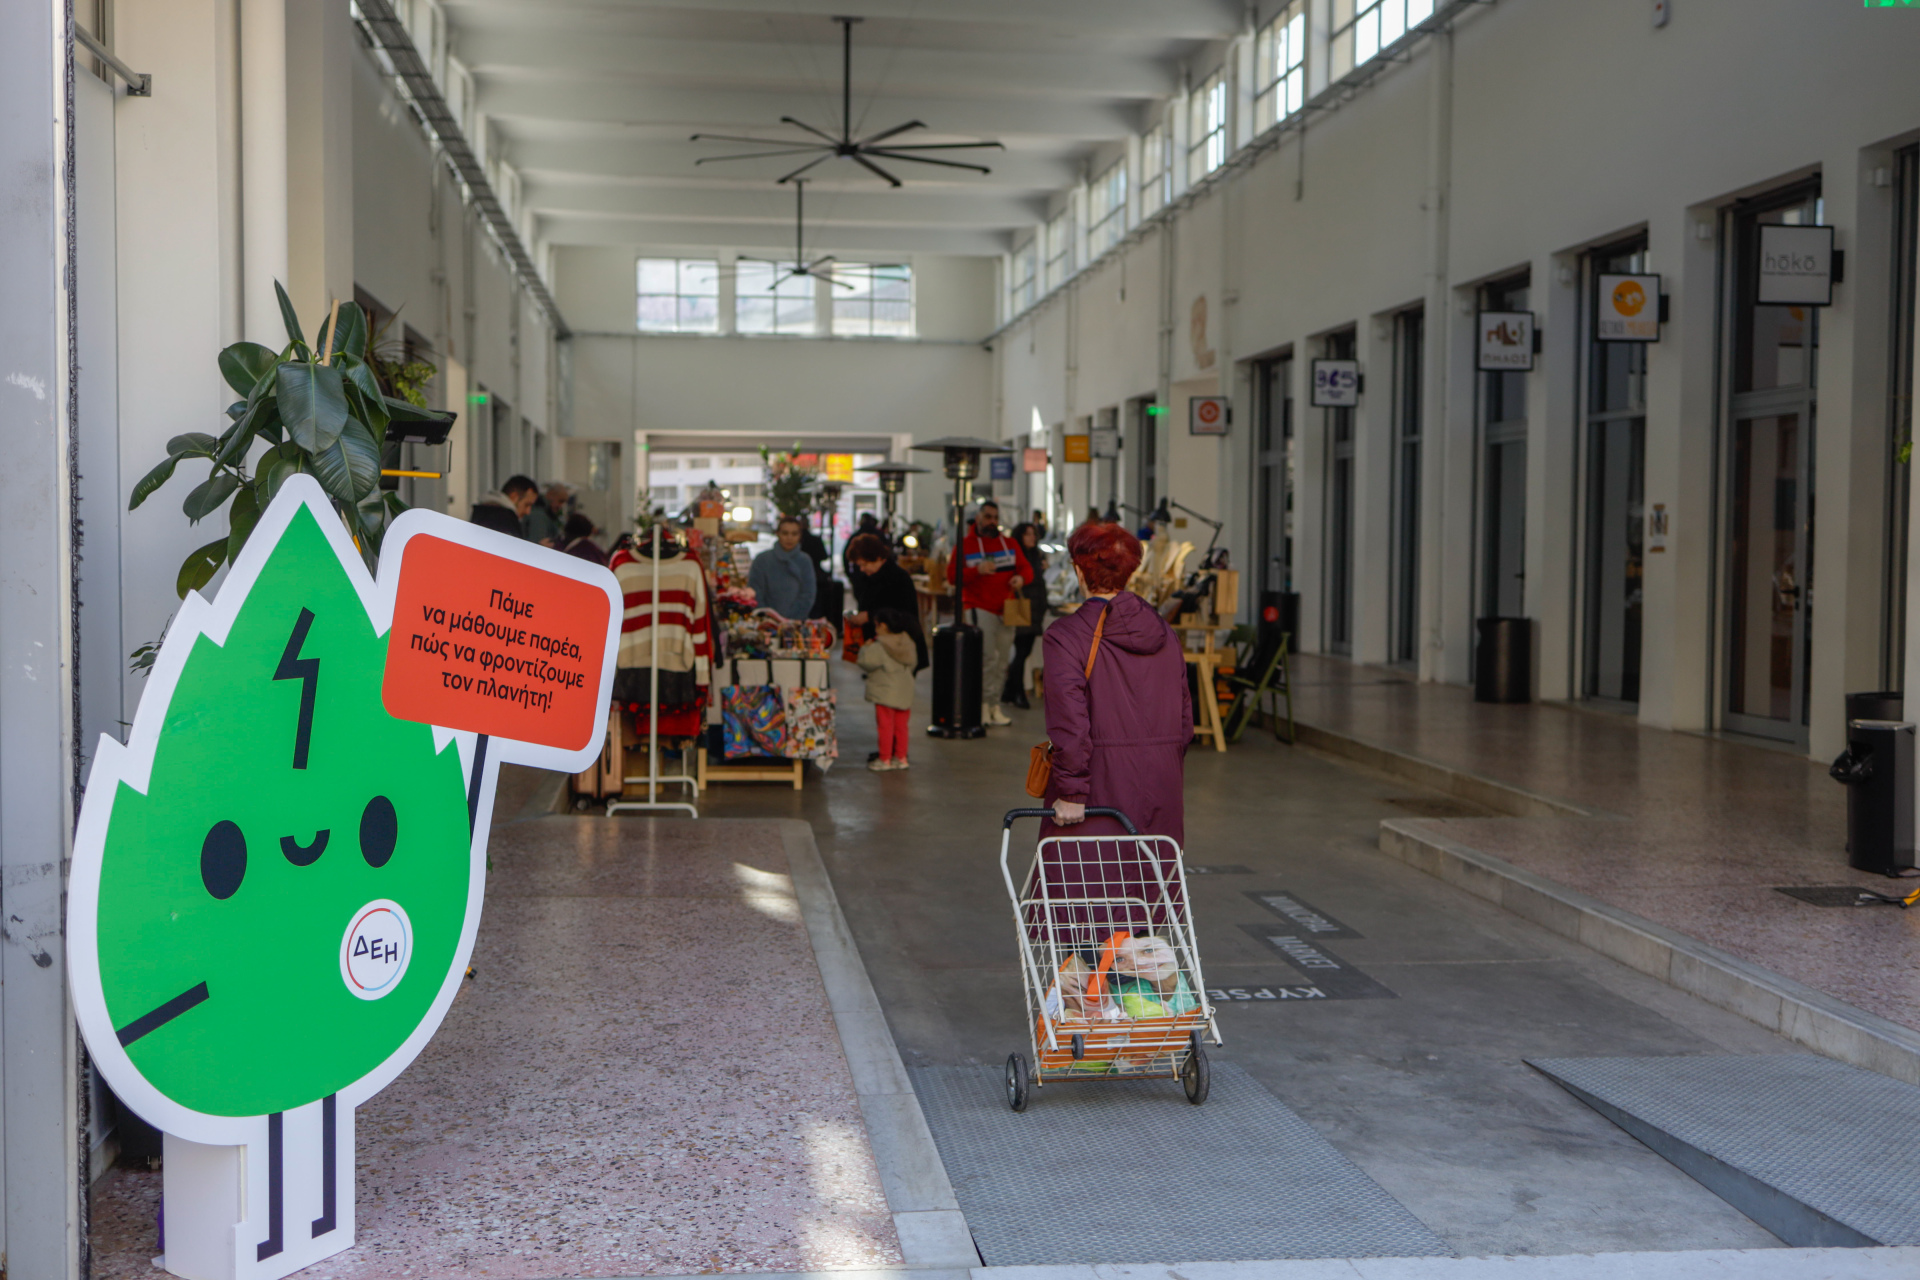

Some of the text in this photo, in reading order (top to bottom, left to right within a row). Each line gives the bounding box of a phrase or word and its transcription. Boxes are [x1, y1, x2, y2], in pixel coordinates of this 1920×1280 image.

[1316, 369, 1357, 388] 365
[489, 588, 535, 619] Πάμε
[422, 605, 582, 662] να μάθουμε παρέα,
[410, 632, 585, 690] πώς να φροντίζουμε
[441, 671, 553, 713] τον πλανήτη!
[353, 935, 398, 964] ΔΕΗ
[1266, 936, 1342, 969] MARKET
[1204, 987, 1327, 1001] KYPSE
